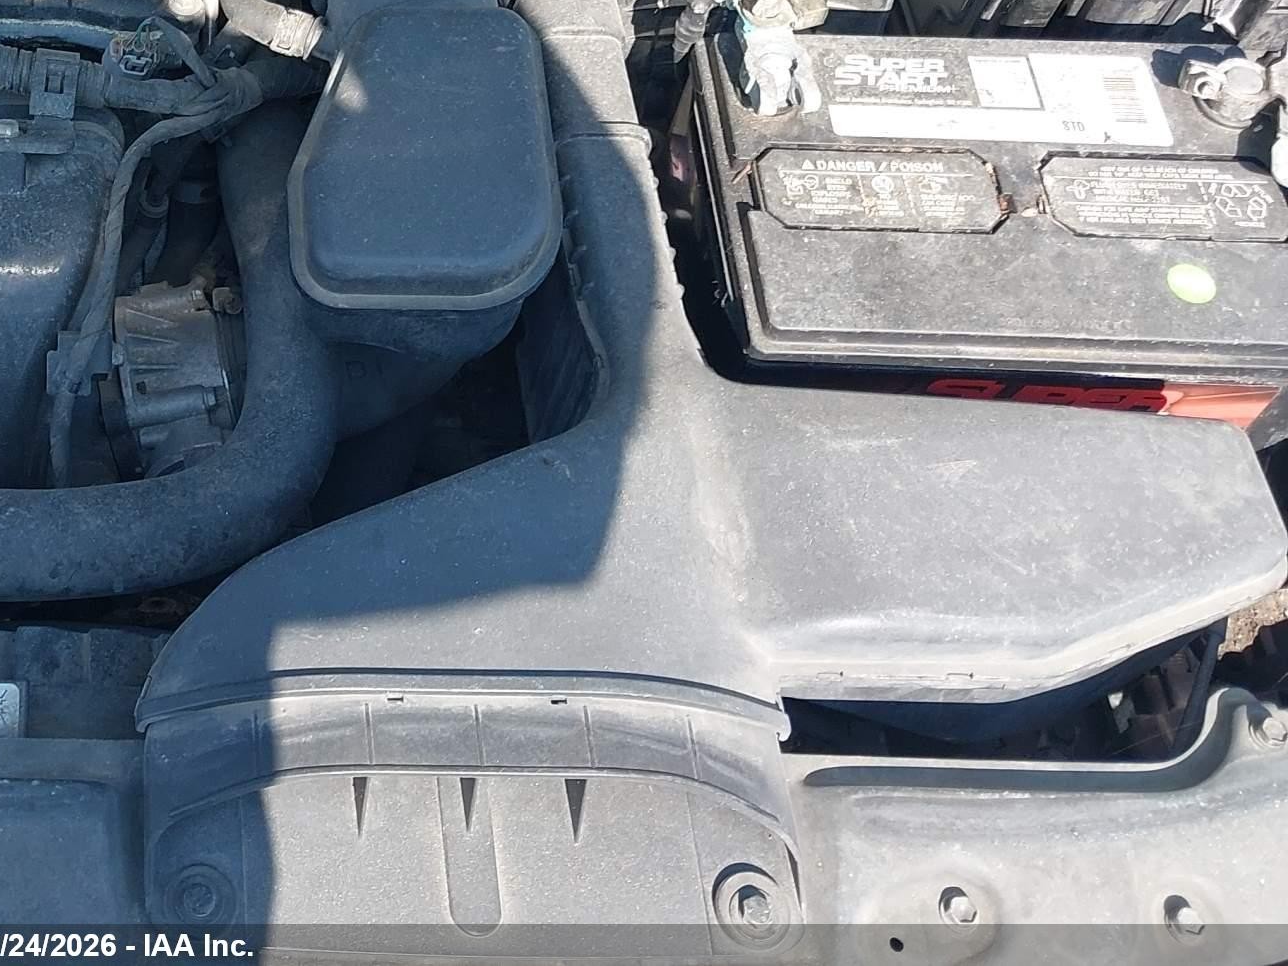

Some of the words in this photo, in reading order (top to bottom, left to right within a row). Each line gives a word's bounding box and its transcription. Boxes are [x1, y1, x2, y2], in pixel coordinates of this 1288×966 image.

[843, 54, 945, 73] SUPER
[833, 66, 949, 86] START
[815, 160, 876, 172] DANGER
[890, 161, 944, 173] POISON
